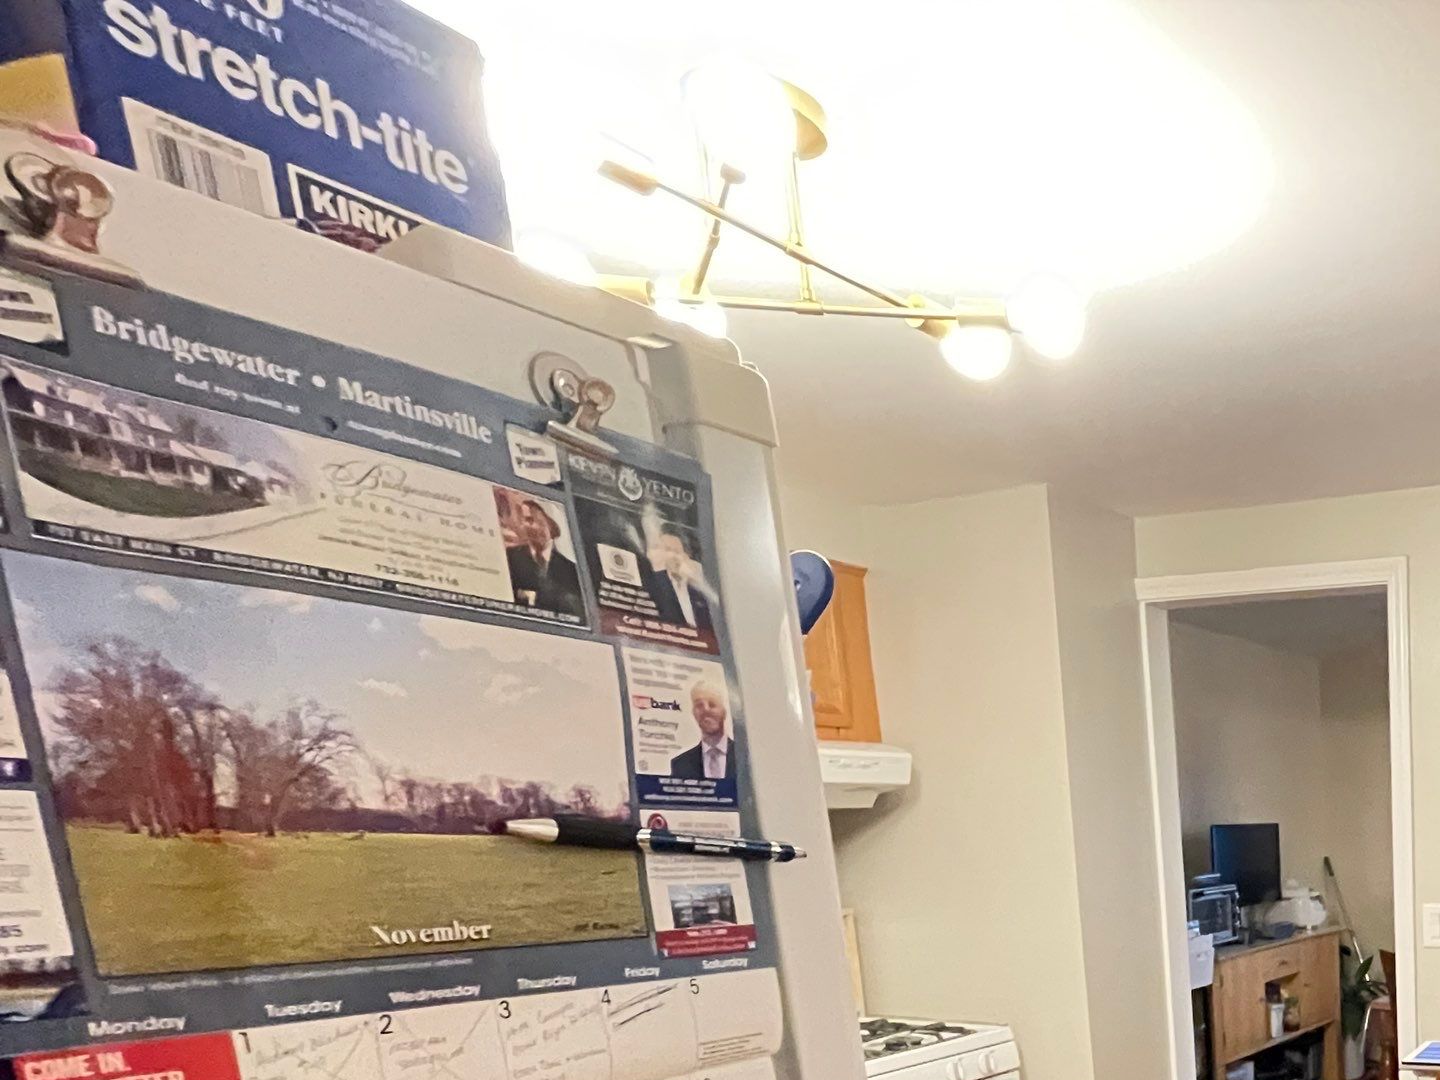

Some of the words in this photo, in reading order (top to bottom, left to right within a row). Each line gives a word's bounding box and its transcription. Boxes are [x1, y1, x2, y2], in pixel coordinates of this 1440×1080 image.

[103, 0, 469, 194] stretch-tite
[91, 304, 301, 386] Bridgewater
[337, 376, 493, 444] Martinsville
[650, 698, 682, 712] bank
[370, 920, 493, 946] November
[87, 1015, 187, 1037] Monday
[263, 1000, 343, 1018] Tuesday
[388, 983, 481, 1004] Wednesday
[516, 973, 577, 991] Thursday
[623, 965, 661, 979] Friday
[701, 957, 749, 970] Saturday
[600, 988, 611, 1006] 4
[688, 978, 700, 995] 5
[498, 1000, 513, 1020] 3
[378, 1014, 394, 1034] 2
[238, 1031, 252, 1053] 1
